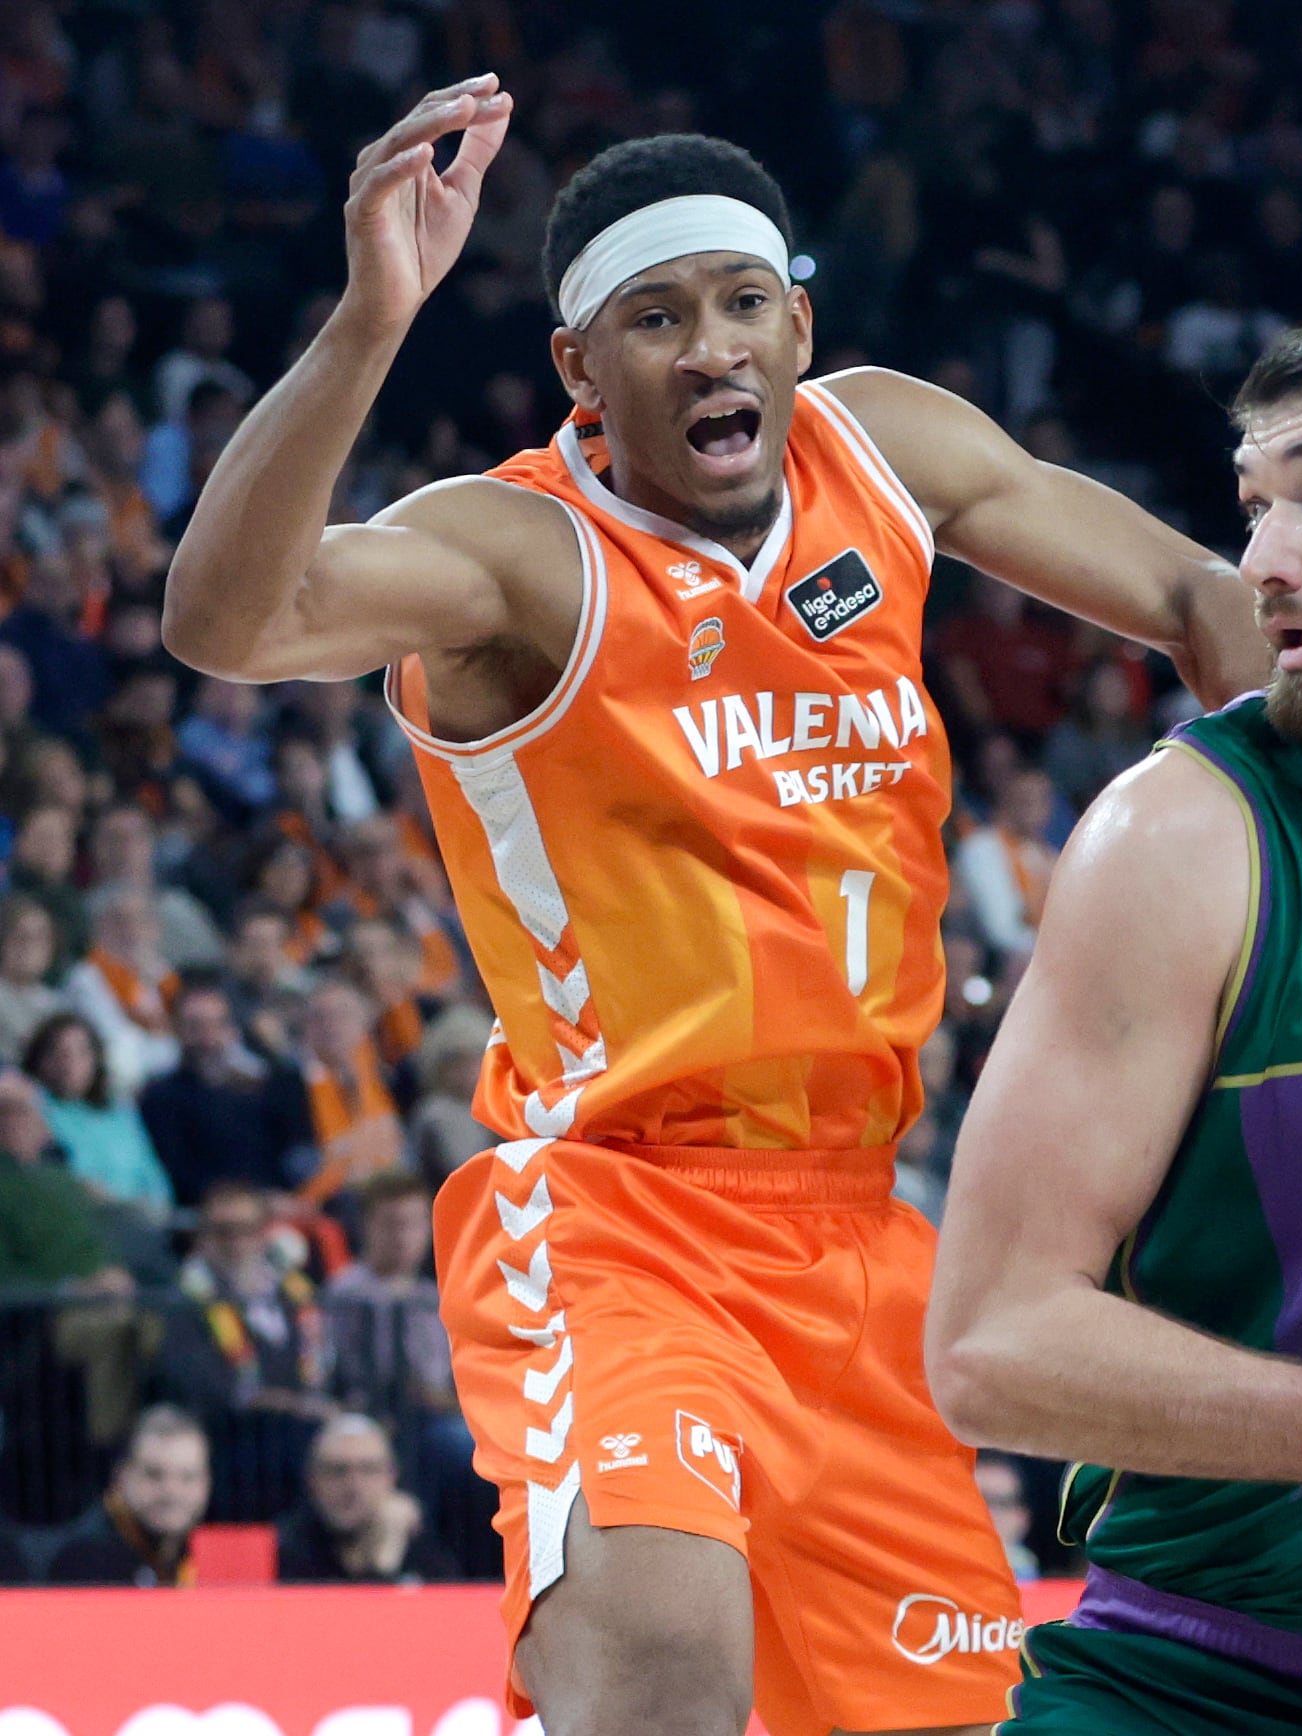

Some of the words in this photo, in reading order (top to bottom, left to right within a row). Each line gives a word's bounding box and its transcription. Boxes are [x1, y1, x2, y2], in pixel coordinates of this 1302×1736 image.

[802, 590, 837, 616] liga
[815, 583, 876, 630] endesa
[773, 761, 912, 807] BASKET
[840, 870, 876, 997] 1
[907, 1606, 1025, 1658] Mide
